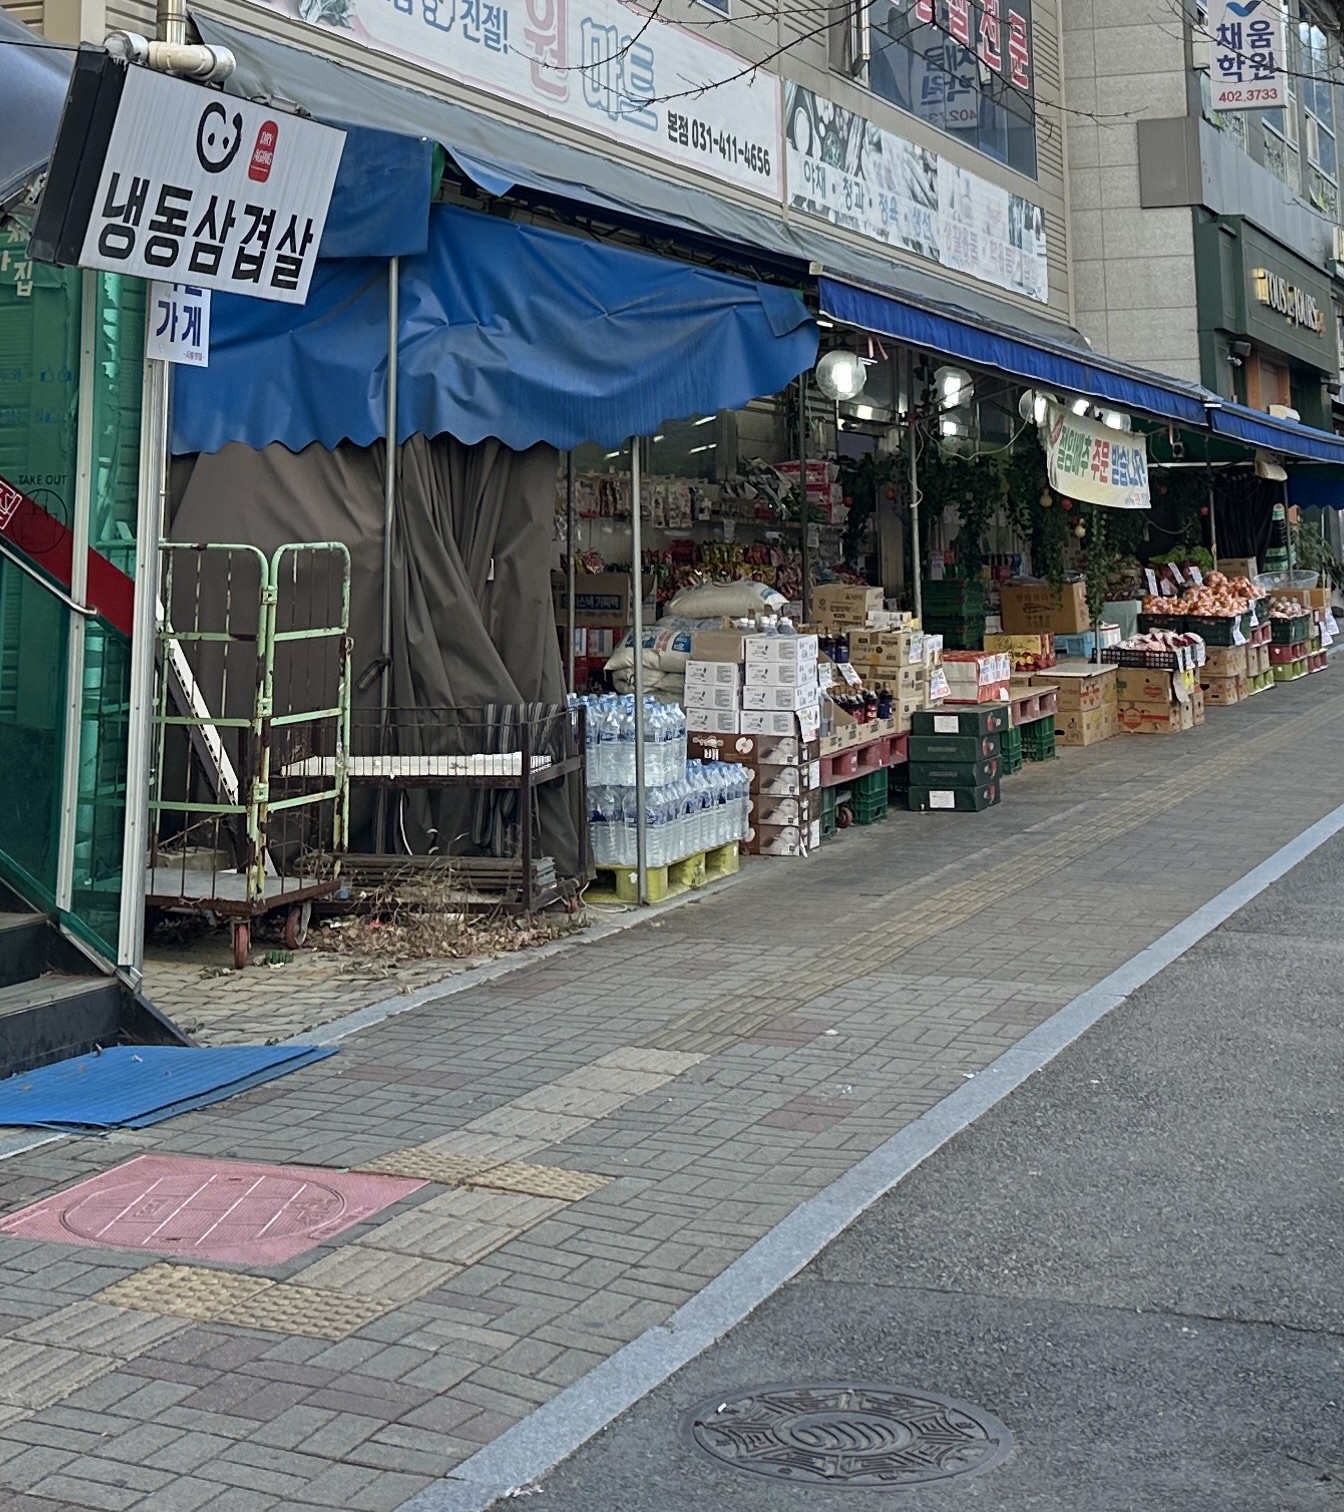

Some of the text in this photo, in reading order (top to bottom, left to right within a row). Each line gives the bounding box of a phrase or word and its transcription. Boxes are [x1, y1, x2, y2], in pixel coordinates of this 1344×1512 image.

[1216, 19, 1275, 51] 채움
[1217, 51, 1276, 83] 학원
[1219, 89, 1278, 103] 402.3733
[259, 131, 274, 145] DRY
[667, 109, 771, 177] 본점 031-411-4656
[803, 159, 826, 196] 야채
[98, 172, 314, 290] 냉동삼겹살
[156, 300, 203, 348] 가게
[1091, 438, 1110, 484] 주문
[17, 473, 68, 486] TAKE OUT
